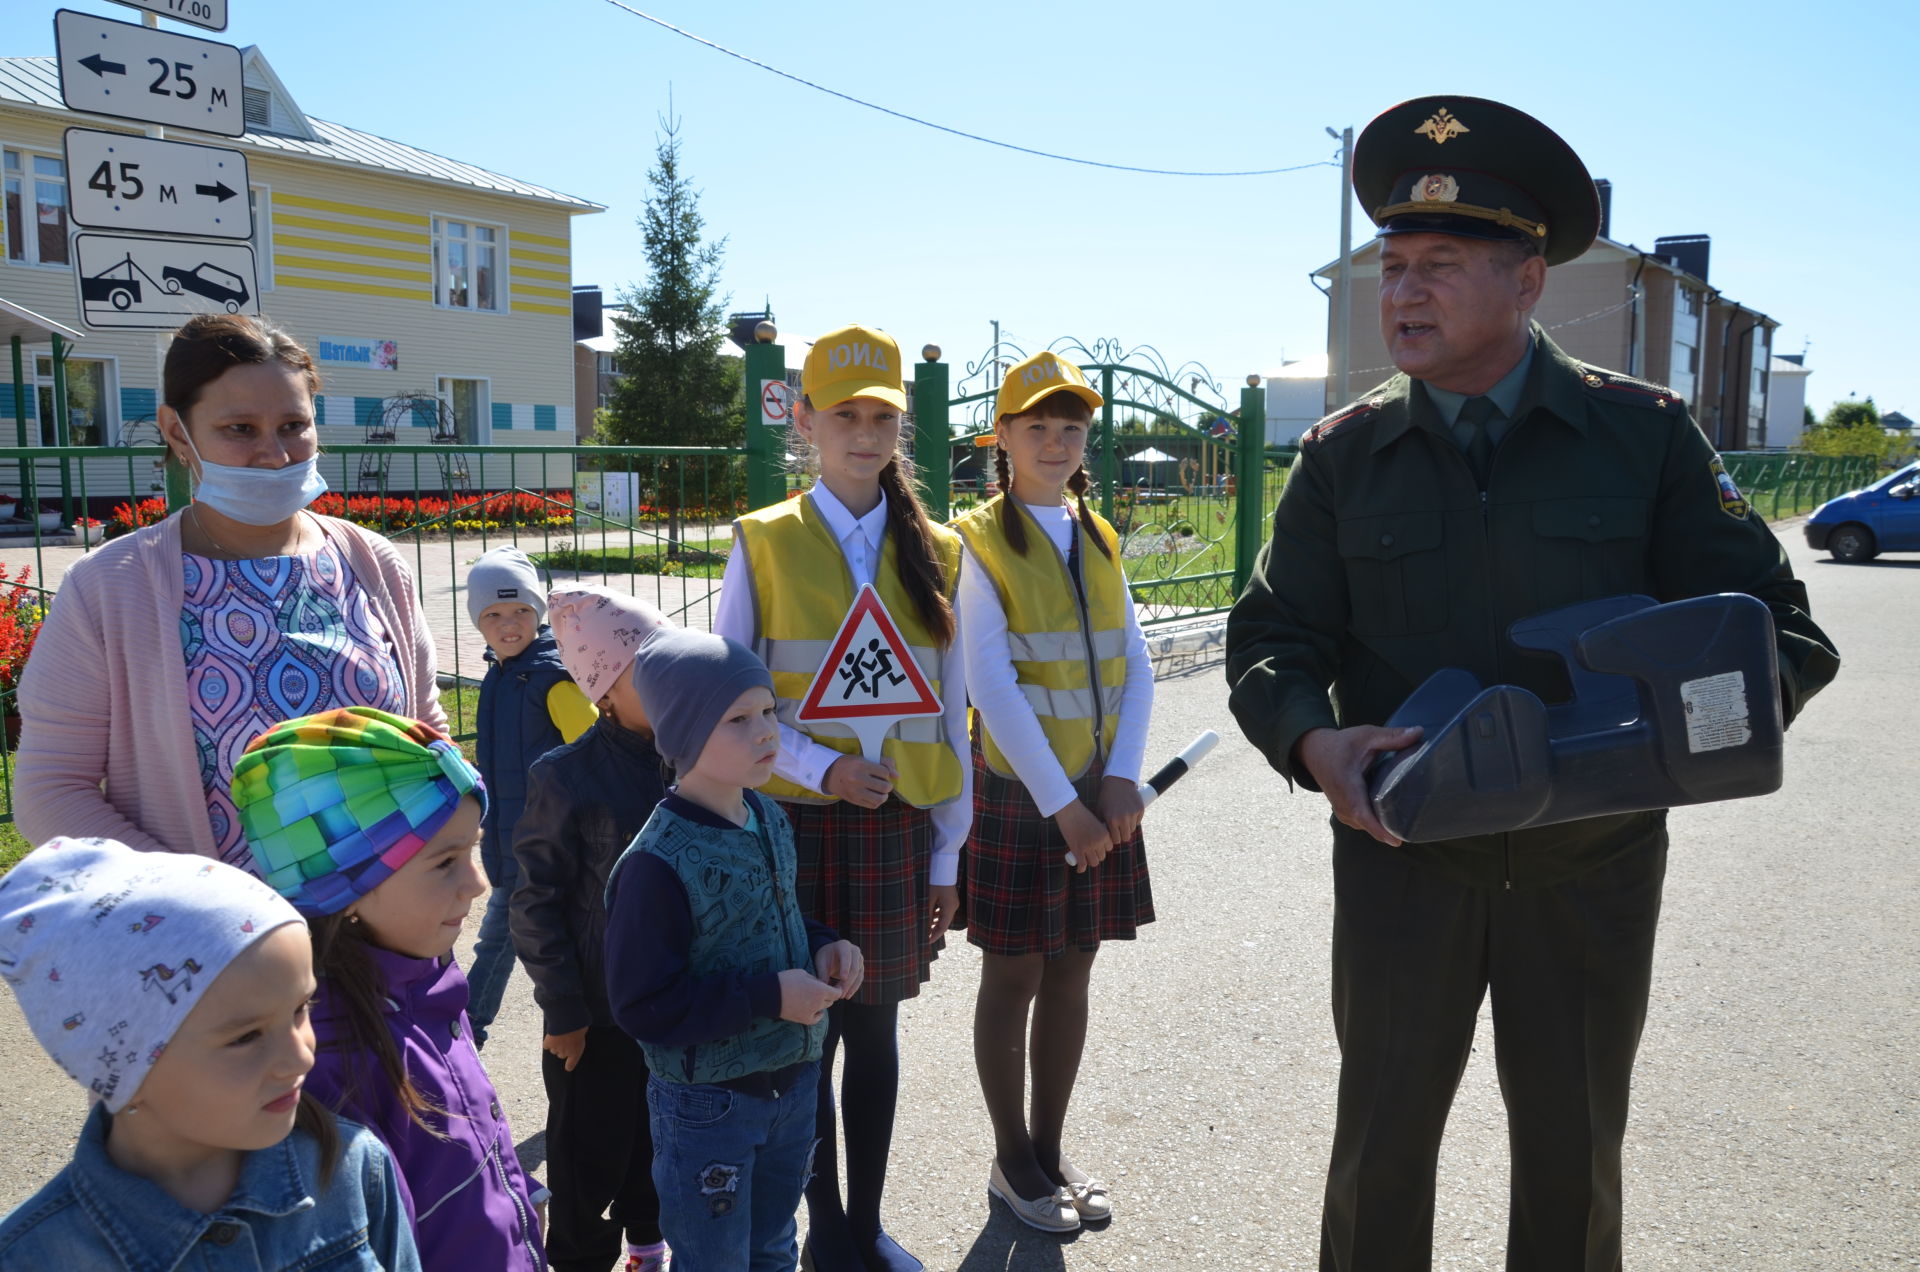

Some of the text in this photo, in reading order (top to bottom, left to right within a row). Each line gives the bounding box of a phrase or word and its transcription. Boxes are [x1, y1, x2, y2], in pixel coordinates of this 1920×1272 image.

[147, 57, 197, 100] 25
[88, 160, 144, 200] 45
[827, 342, 889, 373] ЮИД
[1021, 361, 1062, 387] ЮИ
